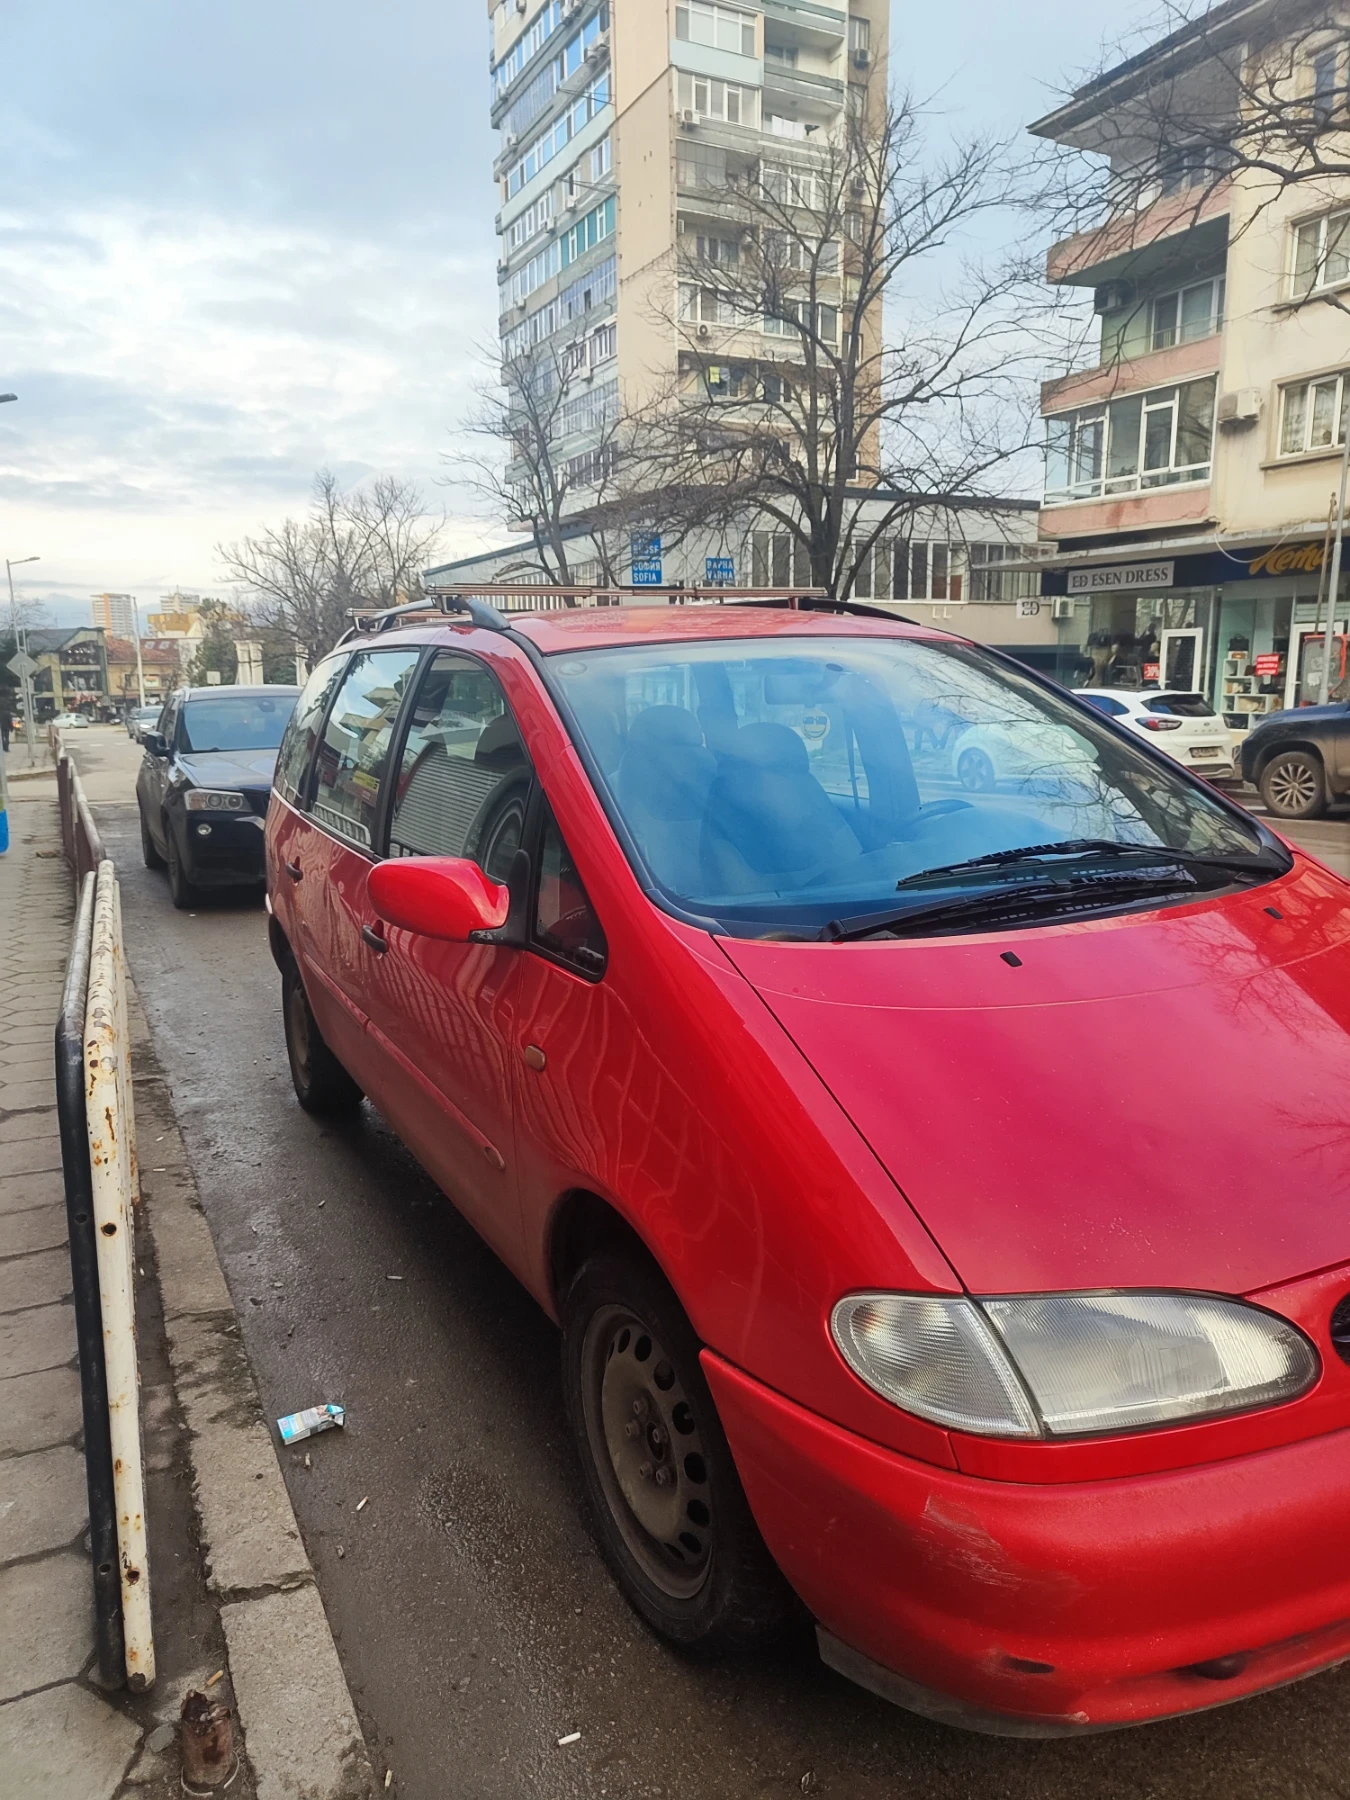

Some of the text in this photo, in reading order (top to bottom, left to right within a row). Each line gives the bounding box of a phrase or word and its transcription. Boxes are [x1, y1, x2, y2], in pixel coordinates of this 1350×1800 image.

[633, 561, 660, 571] СОФИЯ
[633, 572, 657, 582] SOFIA
[707, 570, 733, 580] VARNA
[1072, 567, 1168, 588] ED ESEN DRESS
